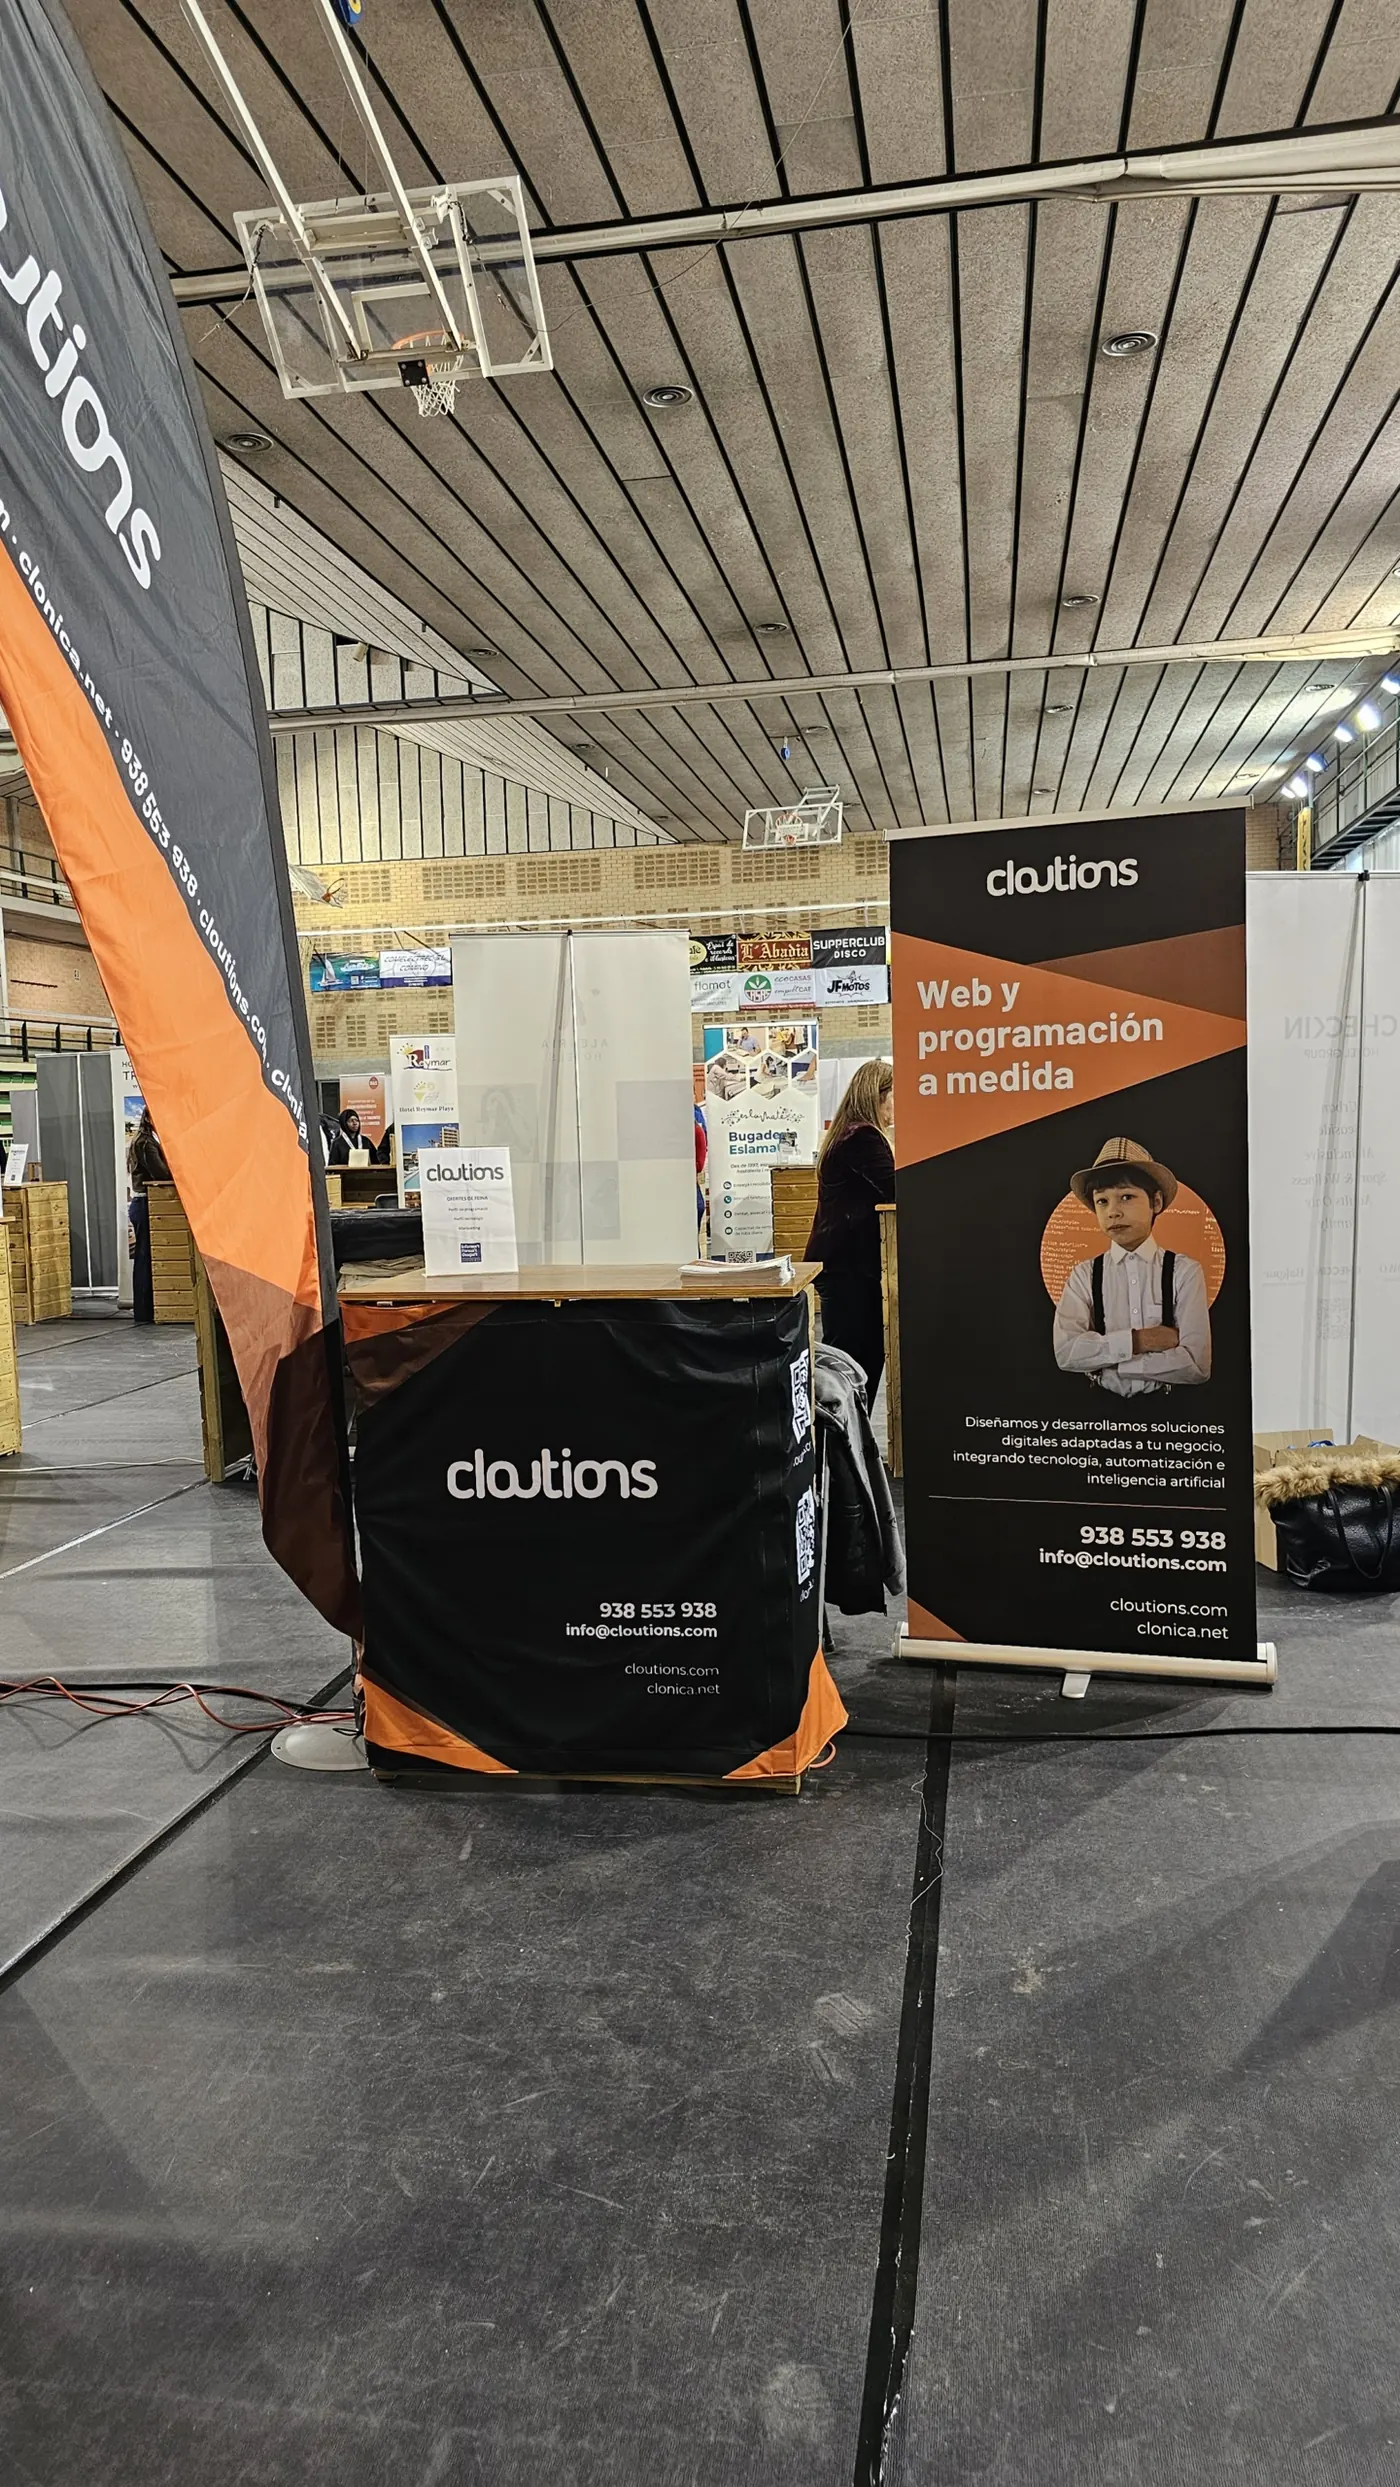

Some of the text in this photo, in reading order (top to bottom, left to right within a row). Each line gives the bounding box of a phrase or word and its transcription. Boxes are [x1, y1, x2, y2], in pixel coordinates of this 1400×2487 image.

[0, 190, 161, 590] utions
[19, 551, 112, 729] clonica.net
[121, 738, 148, 796] 938
[142, 792, 170, 848] 553
[172, 845, 198, 897] 938
[986, 854, 1139, 897] cloutions
[813, 935, 885, 950] SUPPERCLUB
[834, 949, 867, 959] DISCO
[917, 977, 1020, 1012] Web y
[918, 1012, 1163, 1060] programación
[918, 1060, 1074, 1096] a medida
[427, 1163, 504, 1182] cloutions
[965, 1416, 1225, 1434] Diseñamos y desarrollamos soluciones
[1001, 1435, 1225, 1454] digitales adaptadas a tu negocio,
[953, 1451, 1226, 1471] integrando tecnología, automatización e
[447, 1448, 658, 1499] cloutions
[1087, 1472, 1225, 1489] inteligencia artificial
[1080, 1525, 1226, 1550] 938 553 938
[1039, 1548, 1227, 1572] info@cloutions.com
[599, 1602, 718, 1619] 938 553 938
[1110, 1598, 1228, 1617] cloutions.com
[565, 1623, 718, 1640] info@cloutions.com
[1137, 1621, 1229, 1640] clonica.net
[625, 1662, 719, 1676] cloutions.com
[647, 1682, 721, 1695] clonica.net
